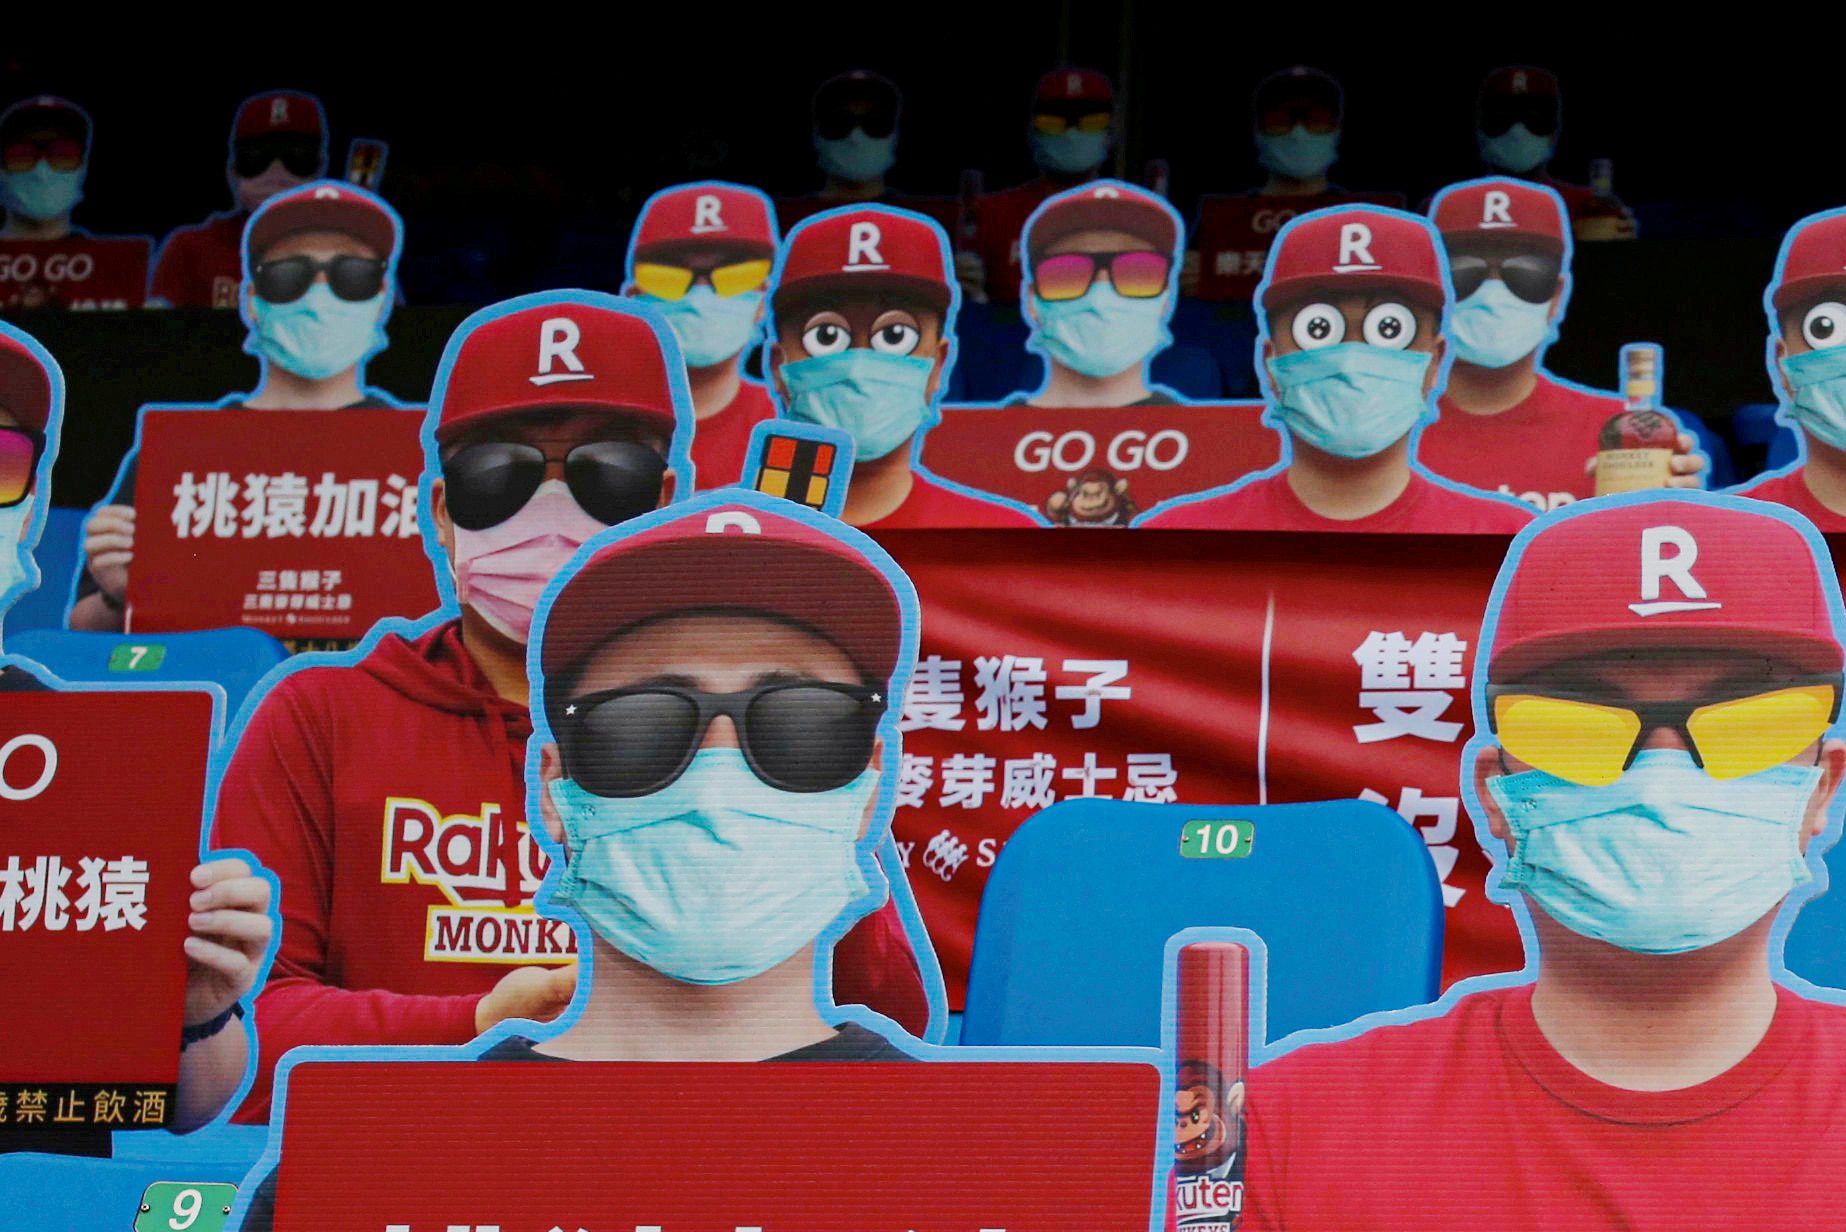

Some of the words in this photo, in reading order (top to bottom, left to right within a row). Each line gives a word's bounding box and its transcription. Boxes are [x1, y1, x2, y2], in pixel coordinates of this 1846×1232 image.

[691, 194, 726, 233] R
[1483, 190, 1512, 223] R
[848, 221, 884, 265] R
[1339, 222, 1375, 265] R
[44, 253, 94, 281] GO
[538, 317, 585, 375] R
[1014, 430, 1096, 472] GO
[1107, 429, 1189, 471] GO
[1640, 525, 1708, 600] R
[128, 646, 149, 669] 7
[1195, 823, 1239, 855] 10
[0, 1089, 167, 1124] 禁止飲酒
[168, 1188, 203, 1231] 9
